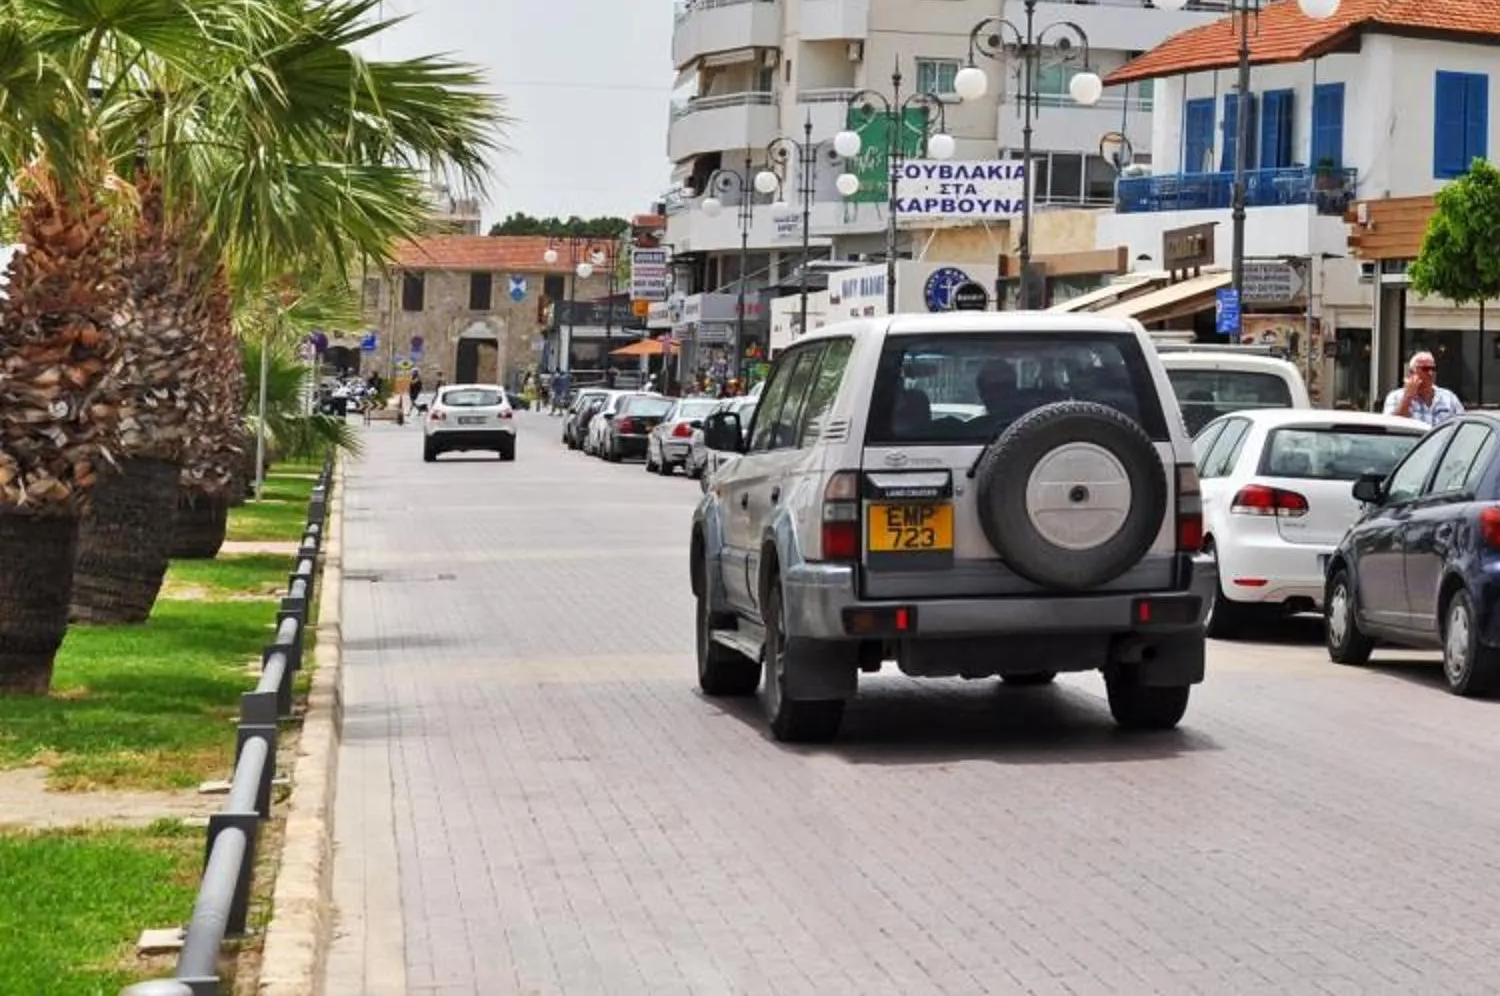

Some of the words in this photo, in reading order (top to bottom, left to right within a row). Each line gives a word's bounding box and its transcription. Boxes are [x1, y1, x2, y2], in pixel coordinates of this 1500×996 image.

[940, 183, 977, 196] ΣΤΑ
[885, 505, 936, 526] EMP
[887, 527, 935, 548] 723
